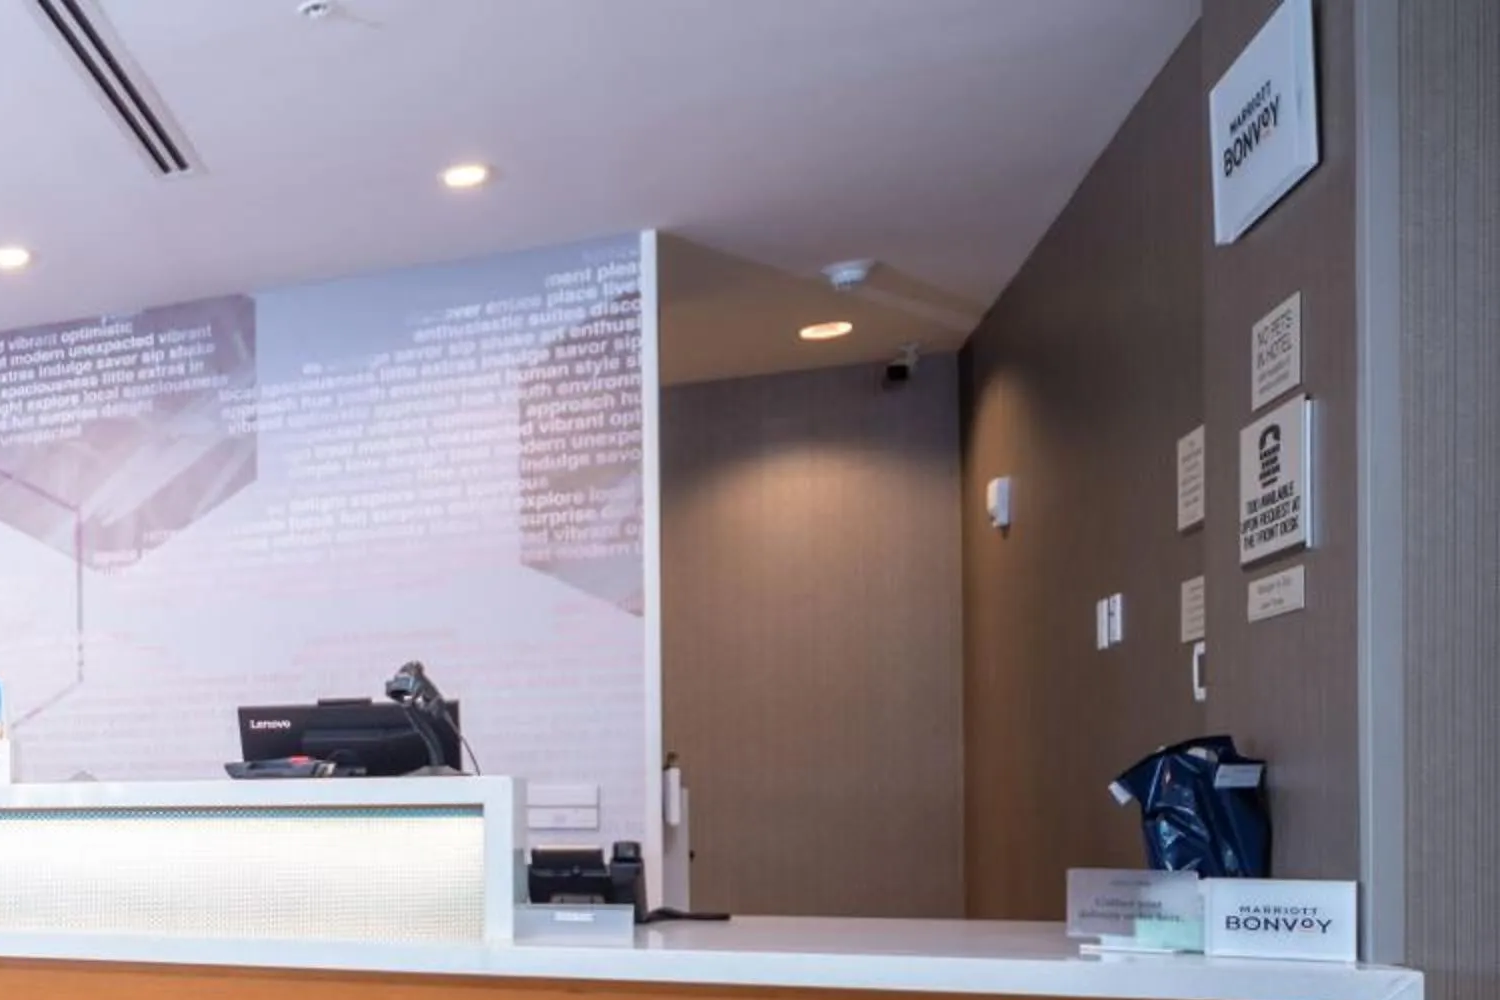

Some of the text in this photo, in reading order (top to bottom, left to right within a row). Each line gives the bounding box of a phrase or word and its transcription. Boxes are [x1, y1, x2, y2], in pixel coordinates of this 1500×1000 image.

[1230, 80, 1271, 136] MARRIOTT
[1223, 95, 1280, 177] BONVOY
[7, 333, 58, 351] vibrant
[60, 322, 133, 346] optimistic
[10, 347, 65, 366] modern
[68, 333, 154, 358] unexpected
[157, 322, 212, 344] vibrant
[554, 340, 608, 360] savor
[38, 359, 93, 380] indulge
[96, 353, 138, 371] savor
[141, 348, 165, 366] sip
[505, 364, 569, 386] human
[575, 355, 619, 378] style
[1, 375, 98, 400] spaciousness
[137, 362, 185, 381] extras
[82, 387, 119, 402] local
[525, 392, 615, 419] approach
[539, 411, 603, 433] vibrant
[1260, 480, 1296, 507] AVAILABLE
[1260, 500, 1291, 525] REQUEST
[250, 719, 291, 730] Lenovo
[1238, 904, 1319, 916] MARRIOTT
[1224, 915, 1333, 934] BONVOY
